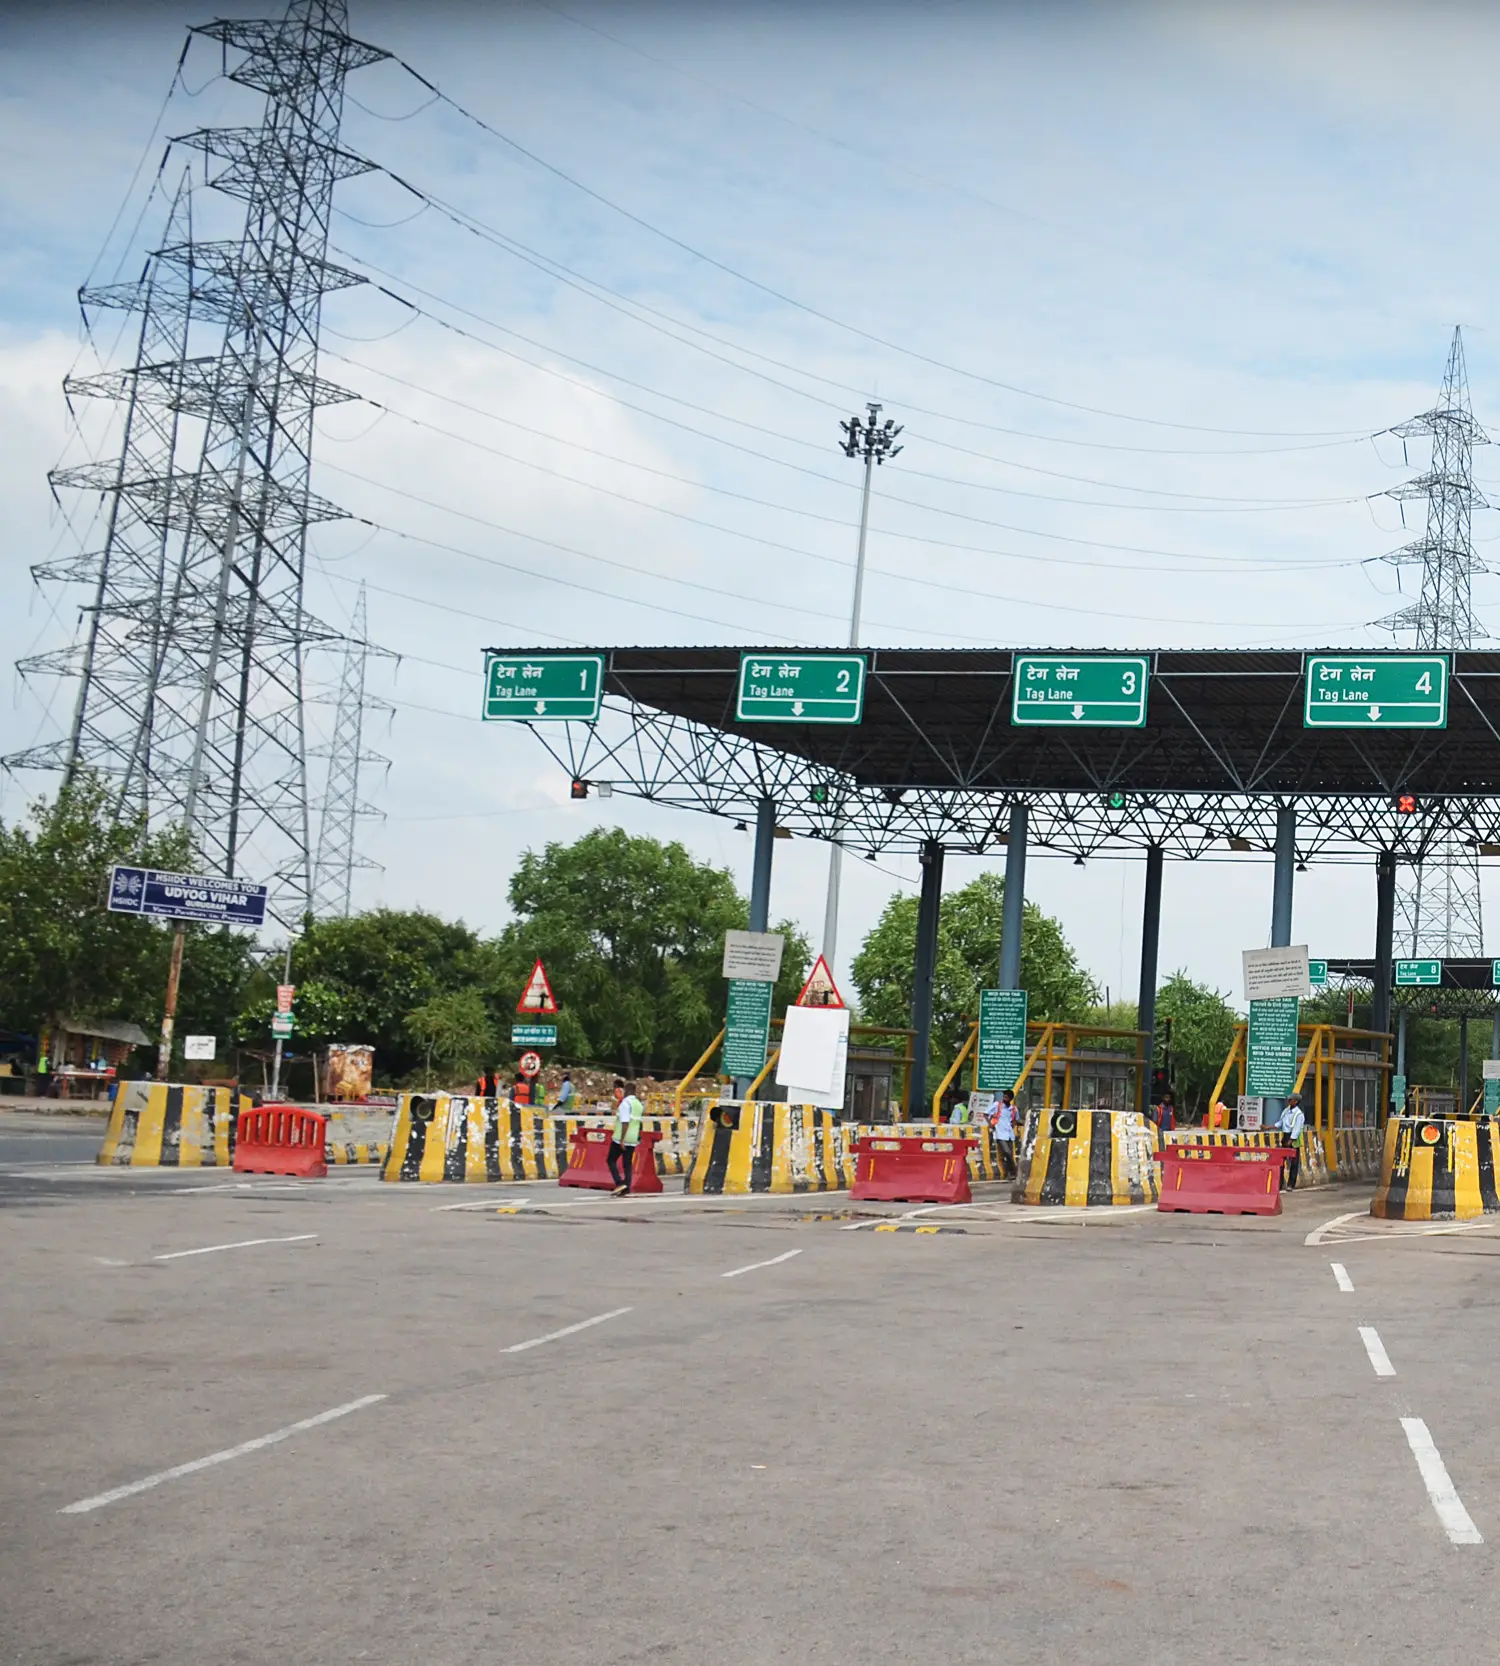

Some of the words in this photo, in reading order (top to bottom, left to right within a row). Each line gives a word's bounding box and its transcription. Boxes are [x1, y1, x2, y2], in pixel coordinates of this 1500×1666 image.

[497, 664, 517, 679] टेग
[522, 664, 544, 679] लेन
[751, 662, 773, 678] टेग
[778, 663, 802, 679] लेन
[1027, 665, 1049, 681] टेग
[1055, 665, 1080, 681] लेन
[1320, 665, 1343, 682] टेग
[1350, 665, 1376, 682] लेन
[580, 669, 588, 692] 1
[836, 669, 850, 693] 2
[1121, 671, 1136, 695] 3
[1415, 671, 1432, 695] 4
[496, 685, 513, 699] Tag
[515, 686, 537, 697] Lane
[750, 684, 768, 698] Tag
[770, 685, 794, 697] Lane
[1025, 687, 1045, 702] Tag
[1048, 688, 1073, 700] Lane
[1318, 688, 1339, 703] Tag
[1343, 689, 1369, 701] Lane
[188, 877, 239, 891] WELCOMES
[241, 884, 260, 894] YOU
[164, 886, 208, 901] UDYOG
[210, 891, 248, 906] VIHAR
[1318, 965, 1324, 975] 7
[1431, 964, 1437, 975] 8
